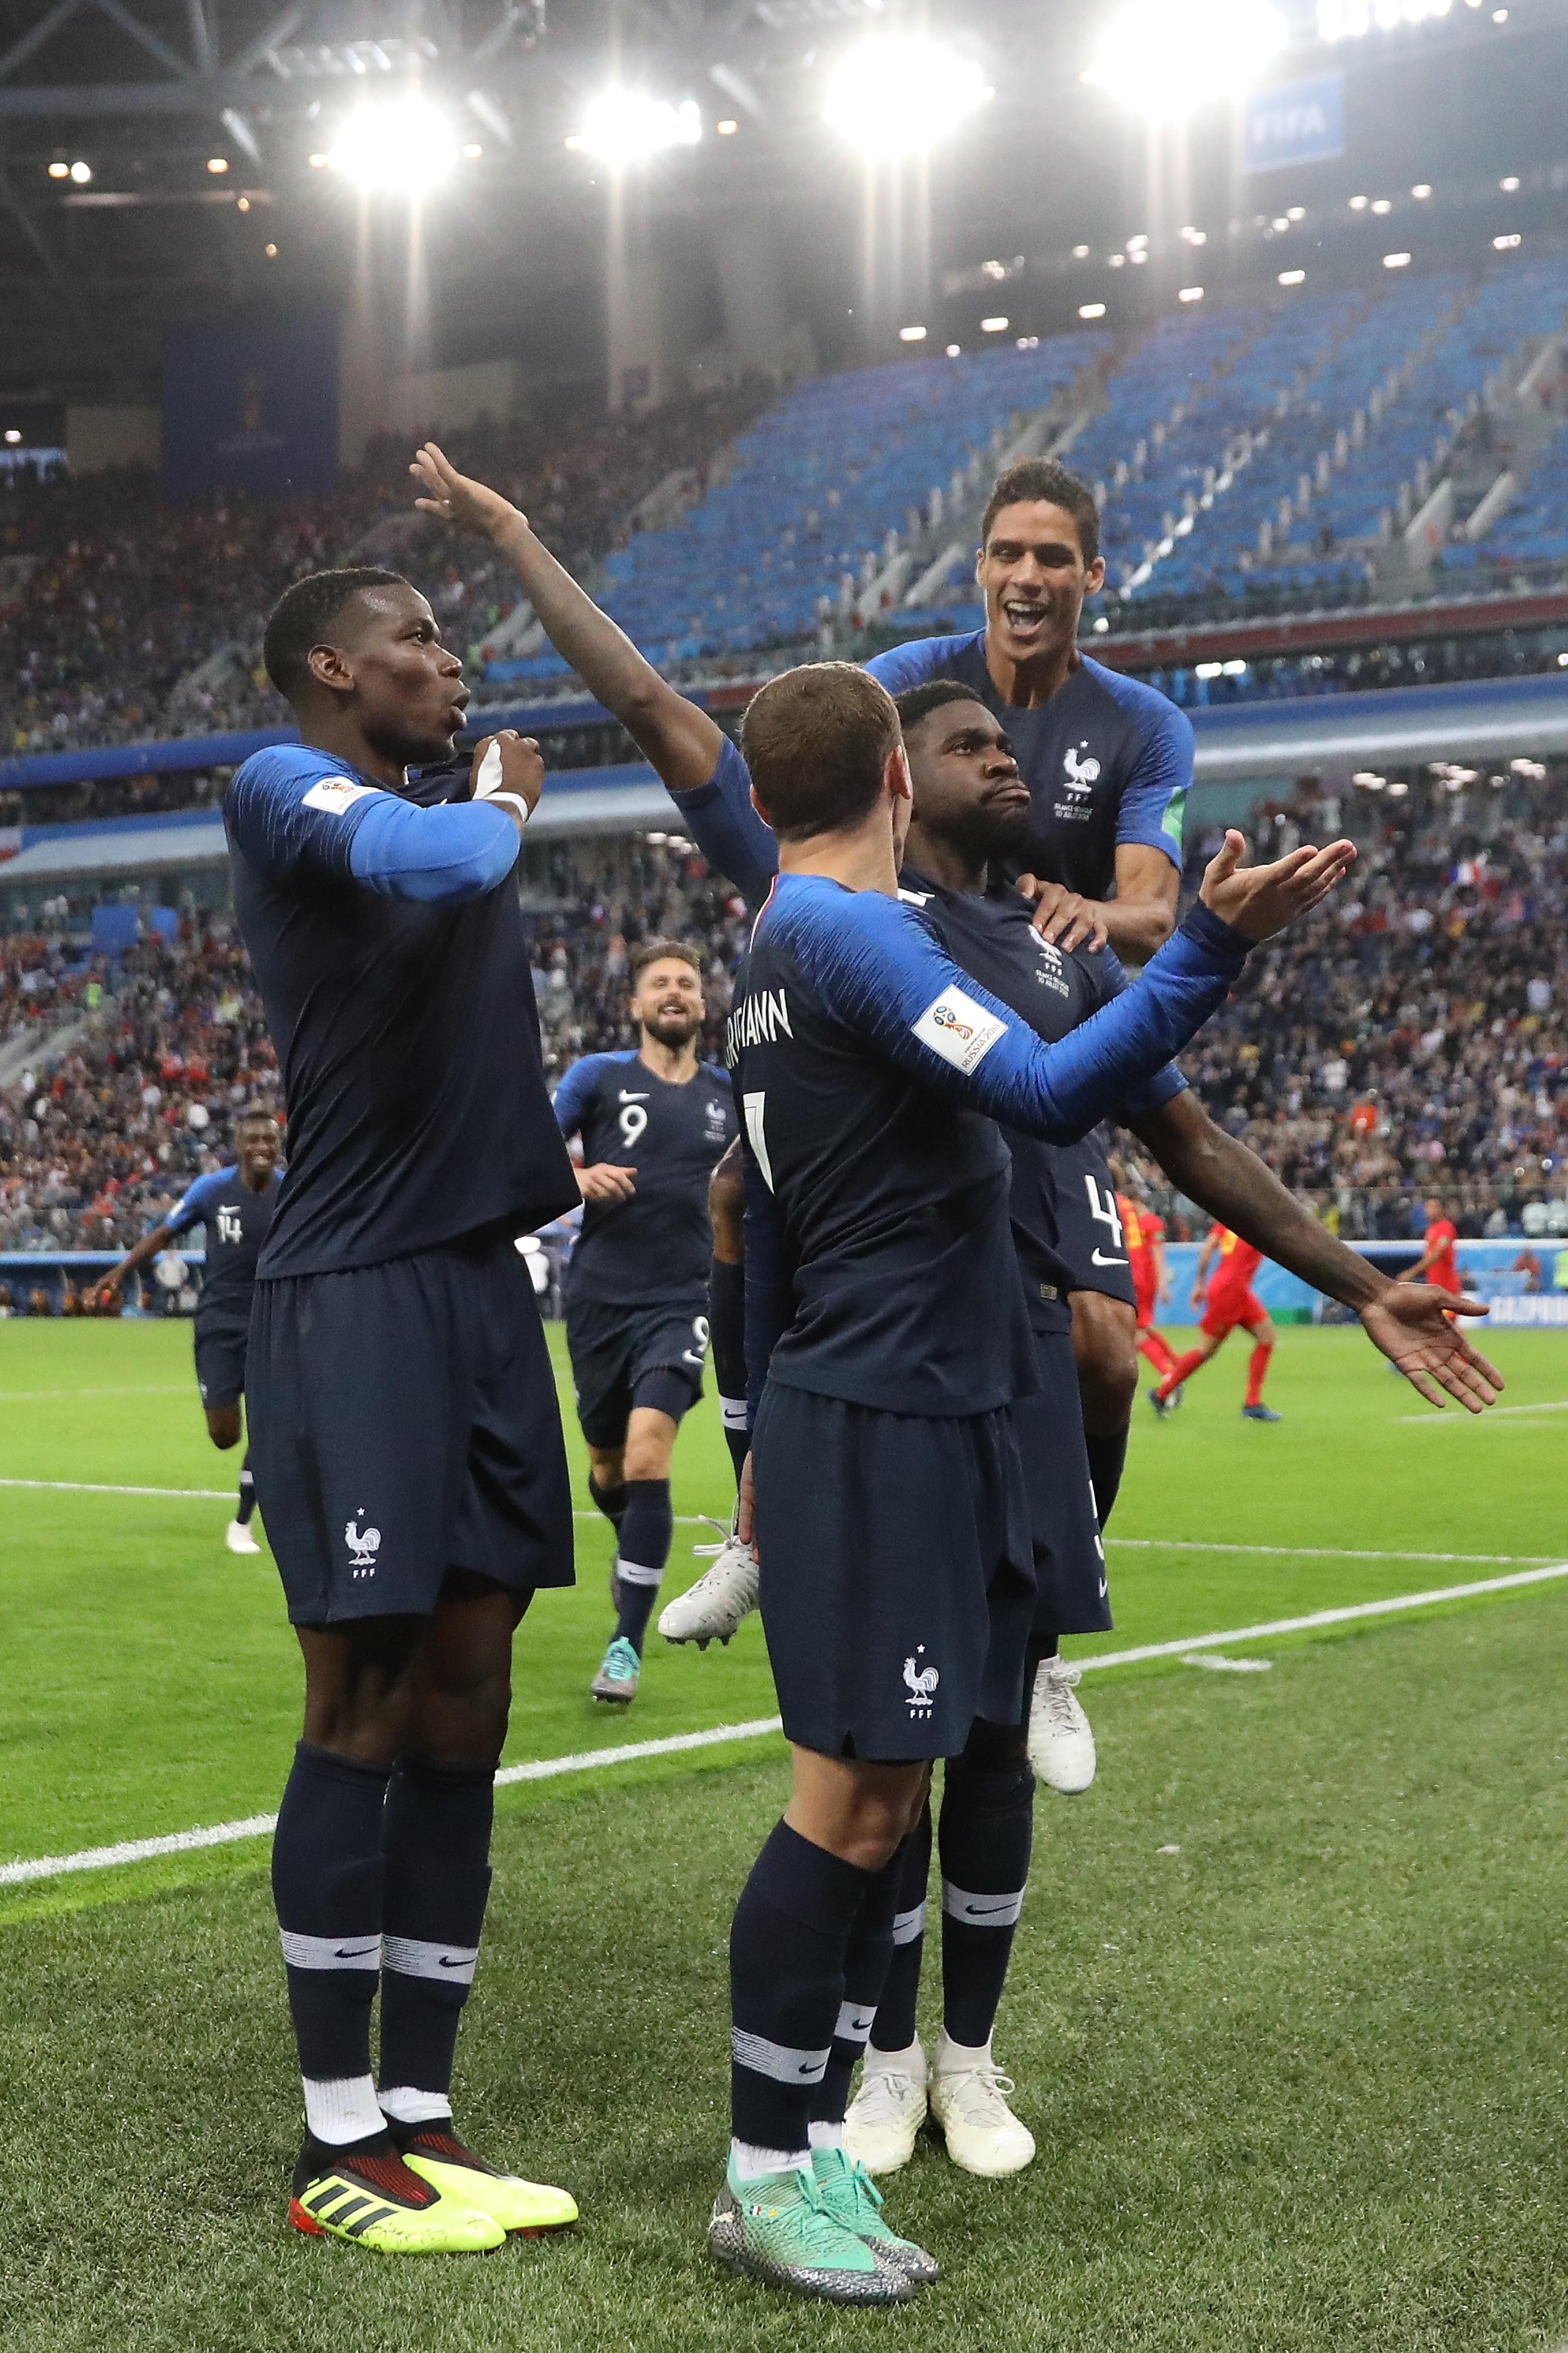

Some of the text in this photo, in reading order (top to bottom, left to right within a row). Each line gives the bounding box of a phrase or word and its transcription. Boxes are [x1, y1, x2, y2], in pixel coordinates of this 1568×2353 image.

[1251, 105, 1325, 143] FIFA
[961, 1023, 1001, 1068] RUSSIA 2018
[620, 1105, 648, 1149] 9
[743, 1091, 775, 1195] 7
[215, 1215, 243, 1244] 14
[1085, 1175, 1123, 1248] 4
[692, 1315, 709, 1352] 9
[353, 1568, 375, 1578] FFF
[910, 1709, 932, 1719] FFF
